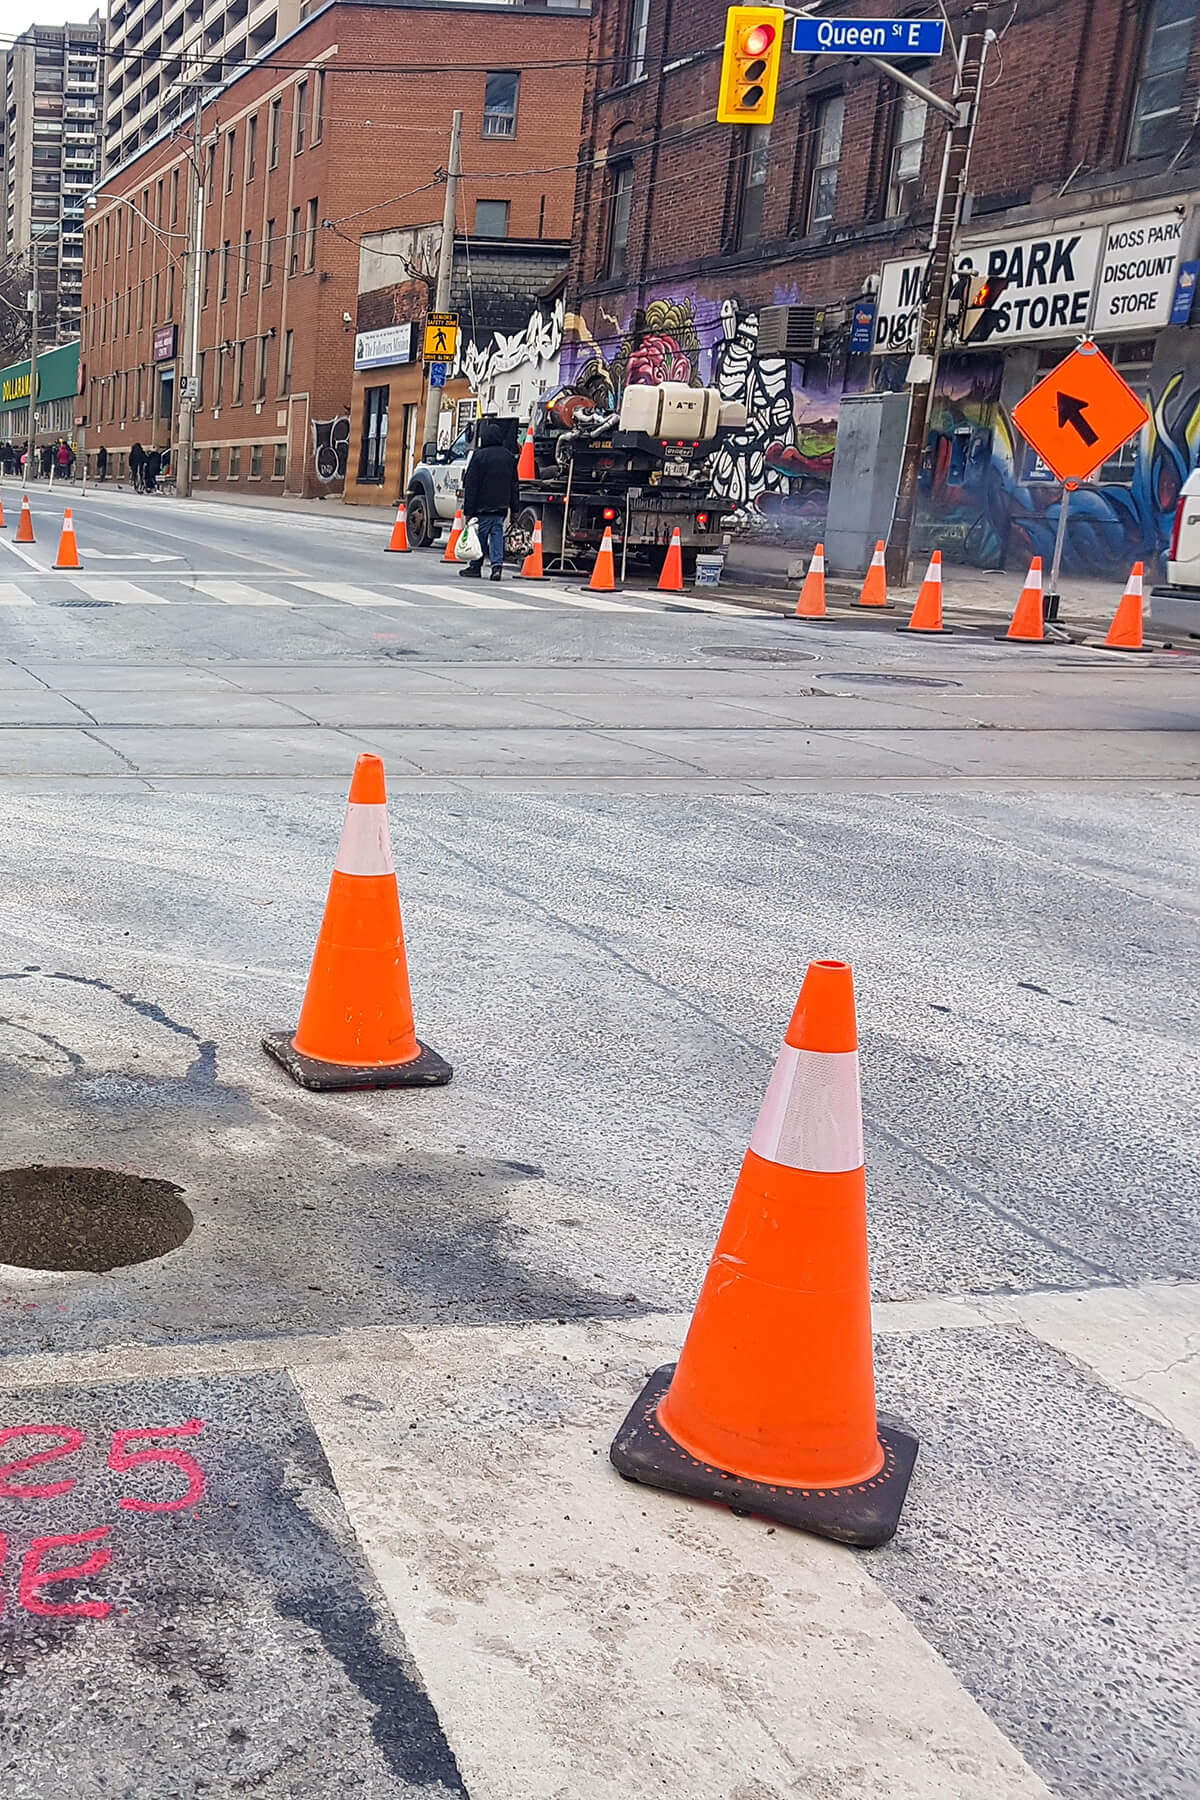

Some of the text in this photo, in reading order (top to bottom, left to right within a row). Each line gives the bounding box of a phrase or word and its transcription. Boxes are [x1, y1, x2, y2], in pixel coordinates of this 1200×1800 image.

[817, 22, 921, 47] Queen St E
[1108, 223, 1181, 251] MOSS PARK
[988, 236, 1081, 289] PARK
[1104, 255, 1176, 283] DISCOUNT
[997, 290, 1090, 333] STORE
[1110, 292, 1158, 315] STORE
